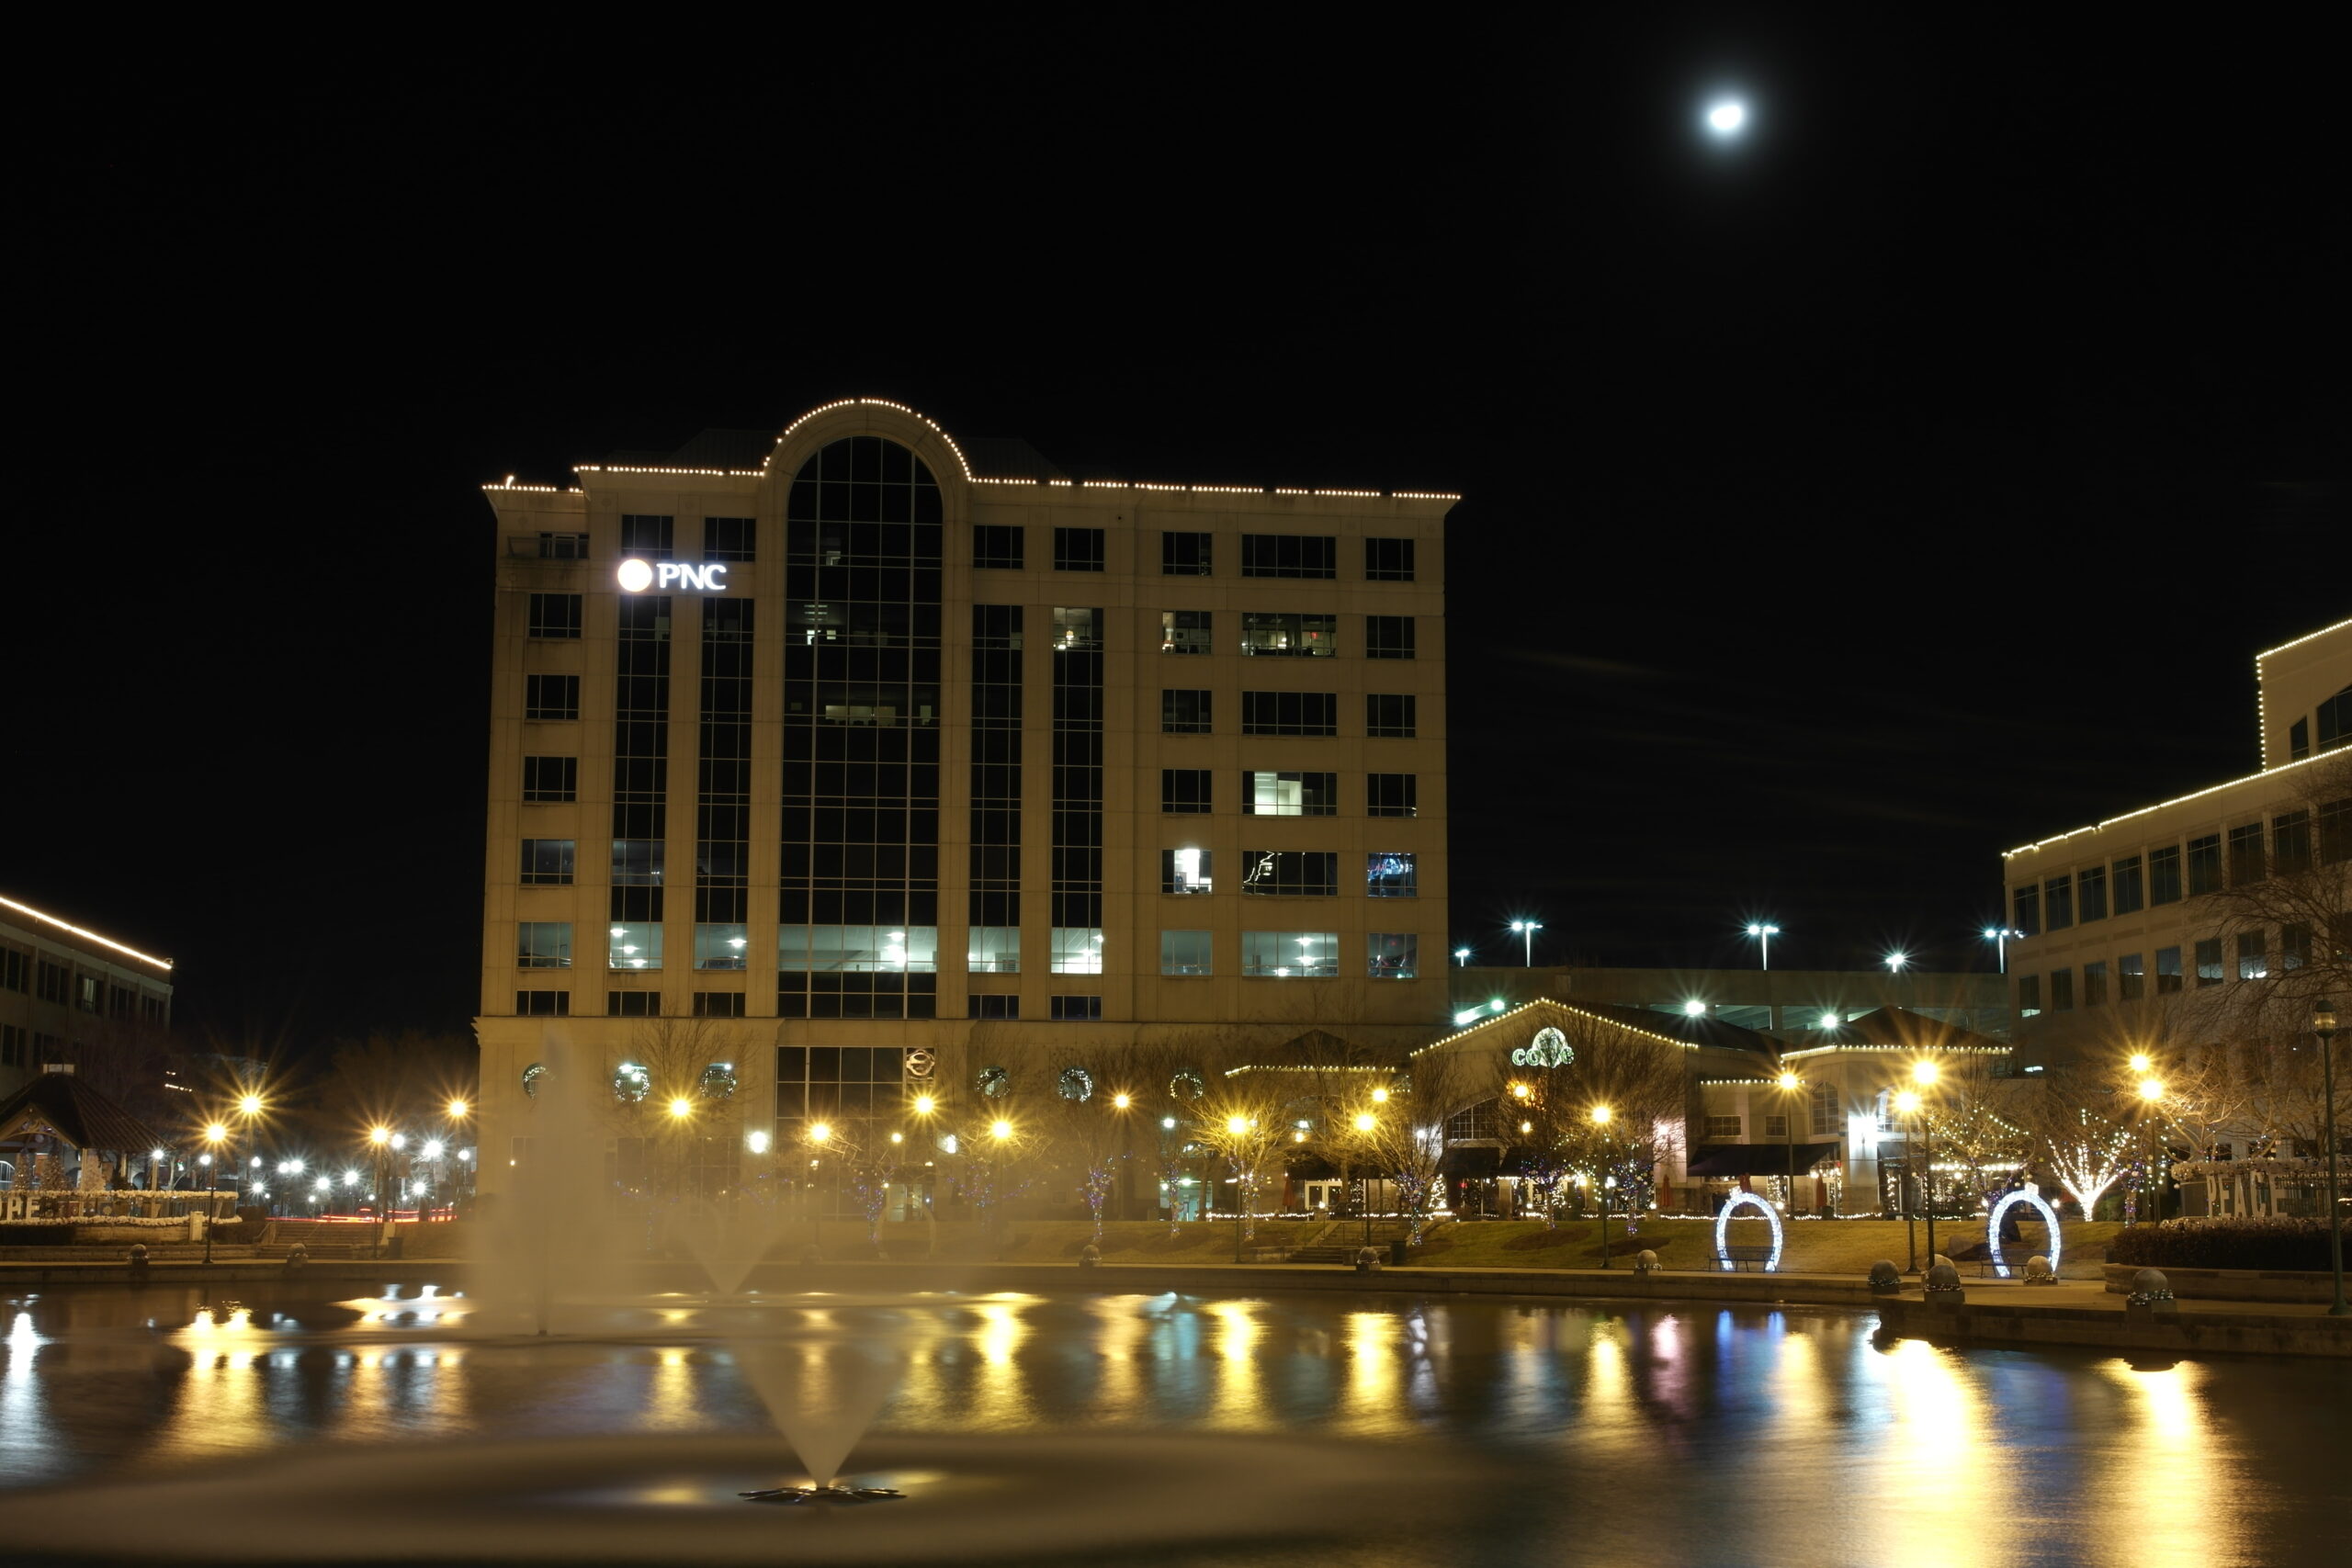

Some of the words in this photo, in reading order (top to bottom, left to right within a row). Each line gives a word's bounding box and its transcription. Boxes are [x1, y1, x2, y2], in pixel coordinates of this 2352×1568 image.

[656, 563, 727, 591] PNC
[0, 1196, 40, 1221] PE
[2206, 1170, 2289, 1219] PEACE
